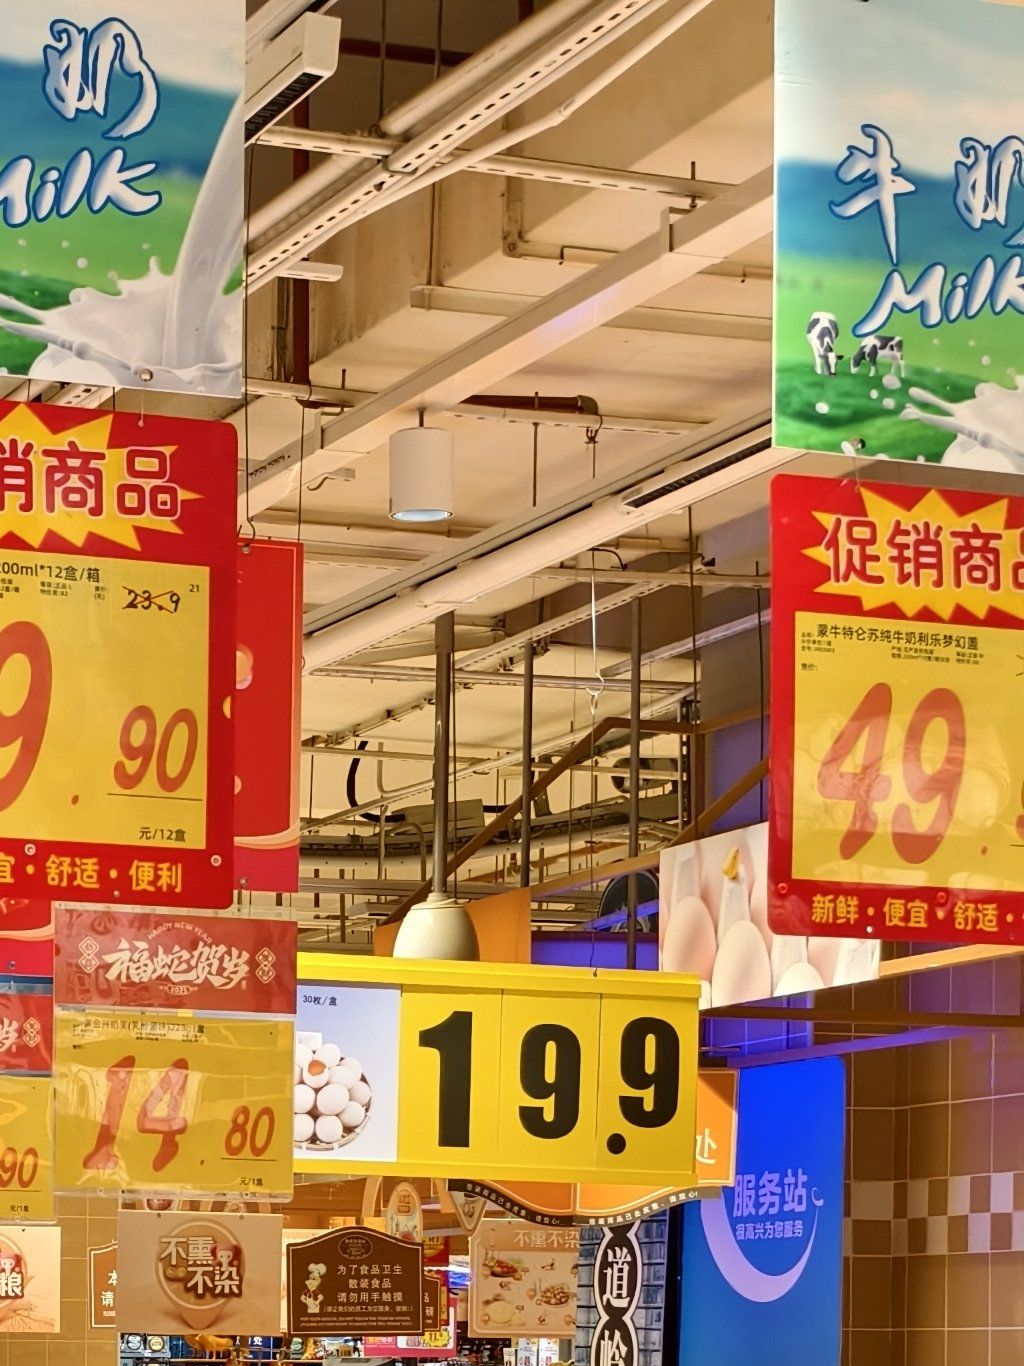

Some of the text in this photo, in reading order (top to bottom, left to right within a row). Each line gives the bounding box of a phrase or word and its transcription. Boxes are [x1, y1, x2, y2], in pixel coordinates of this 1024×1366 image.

[824, 517, 1024, 592] 促销商
[189, 584, 201, 594] 21
[139, 826, 187, 843] 元/12盒
[103, 937, 251, 990] 福蛇贺岁
[733, 1168, 809, 1218] 服务站
[160, 1236, 214, 1265] 不熏
[187, 1266, 239, 1295] 不染
[337, 1264, 403, 1275] 为了食品卫生
[348, 1278, 392, 1289] 散装食品
[337, 1292, 403, 1303] 请勿用手触摸
